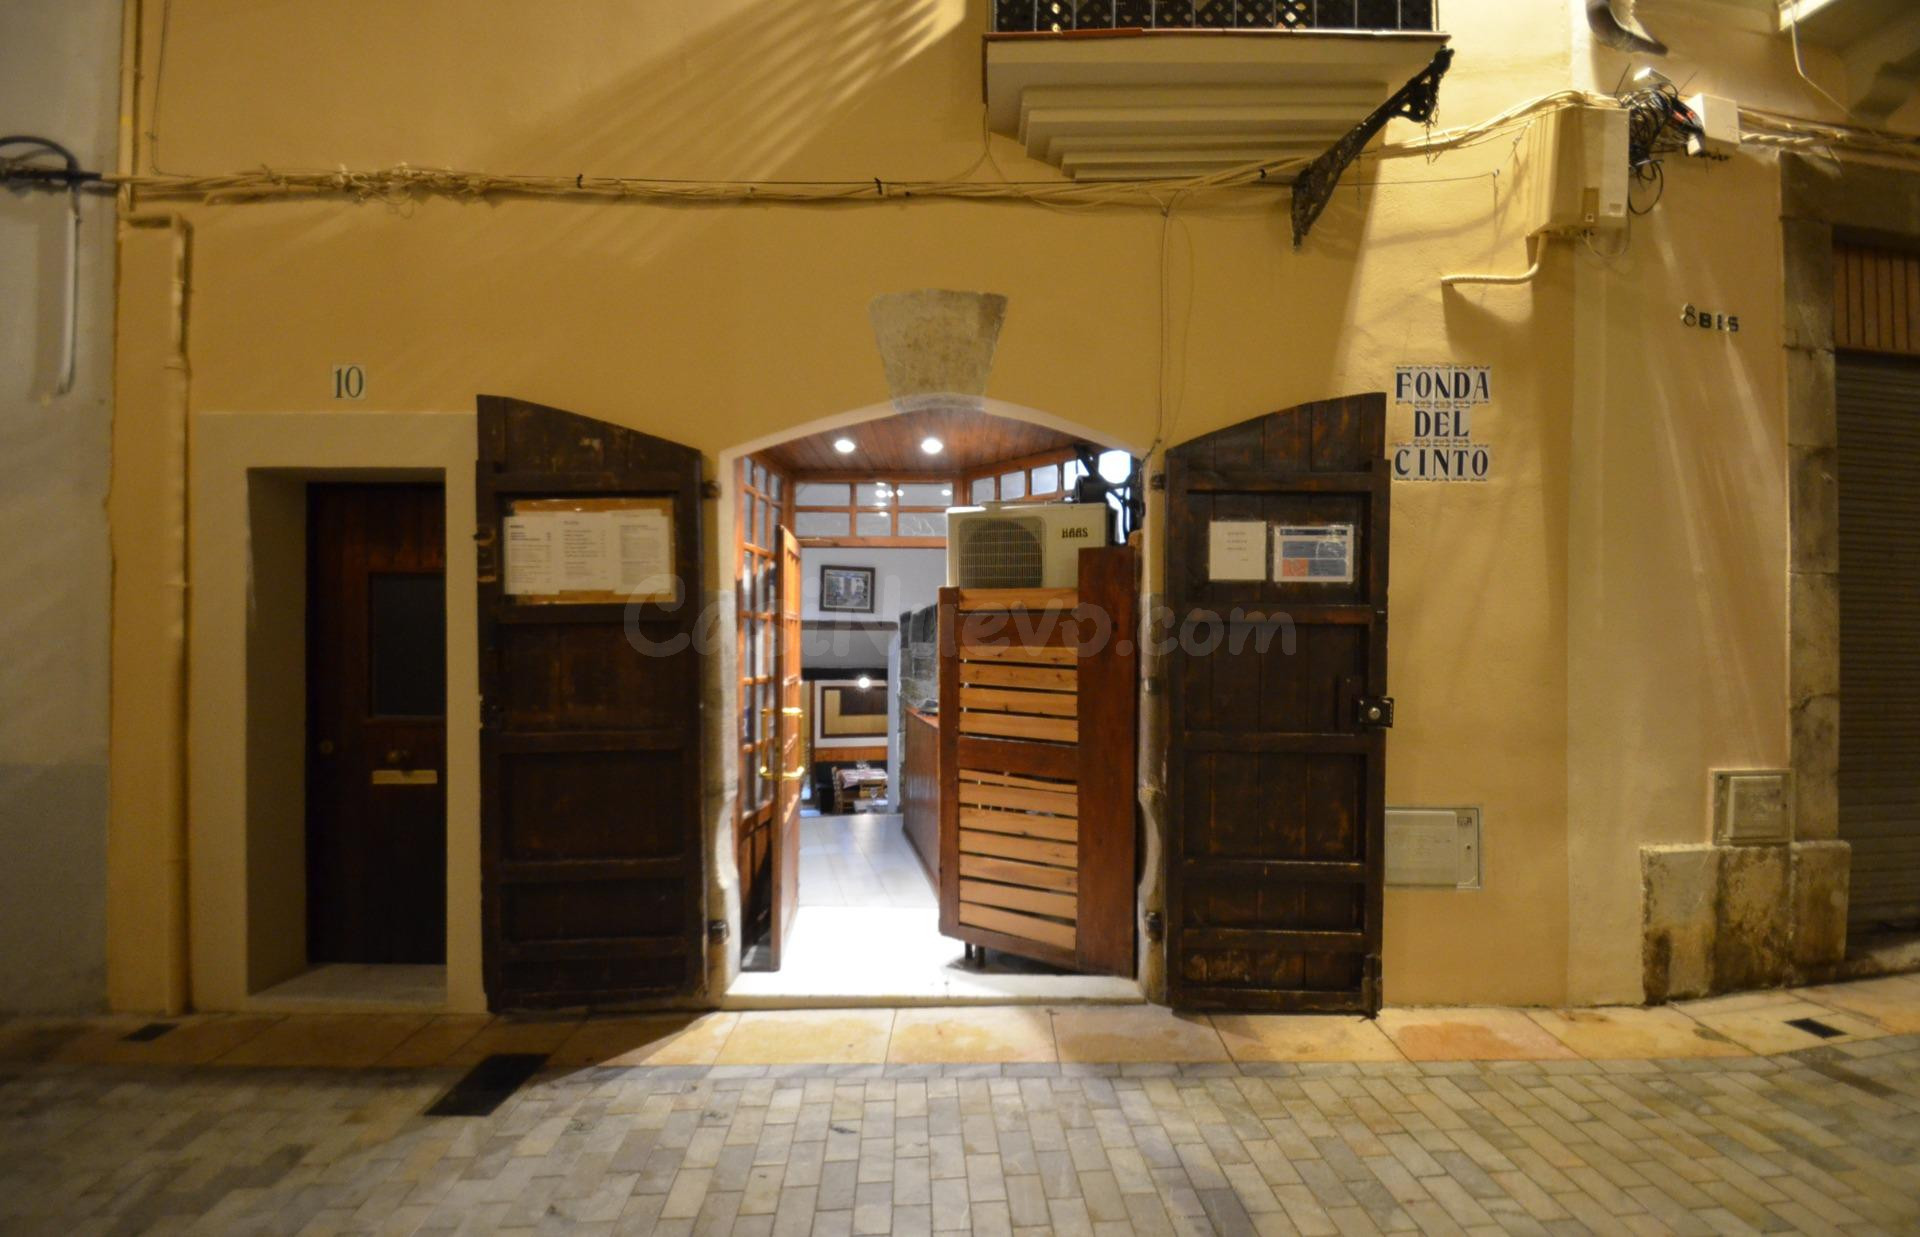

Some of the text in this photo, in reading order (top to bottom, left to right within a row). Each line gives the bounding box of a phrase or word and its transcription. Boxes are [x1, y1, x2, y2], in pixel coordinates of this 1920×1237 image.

[335, 366, 364, 399] 10
[1396, 371, 1489, 399] FONDA
[1414, 410, 1469, 437] DEL
[1394, 449, 1488, 476] CINTO
[1061, 527, 1089, 539] HAAS
